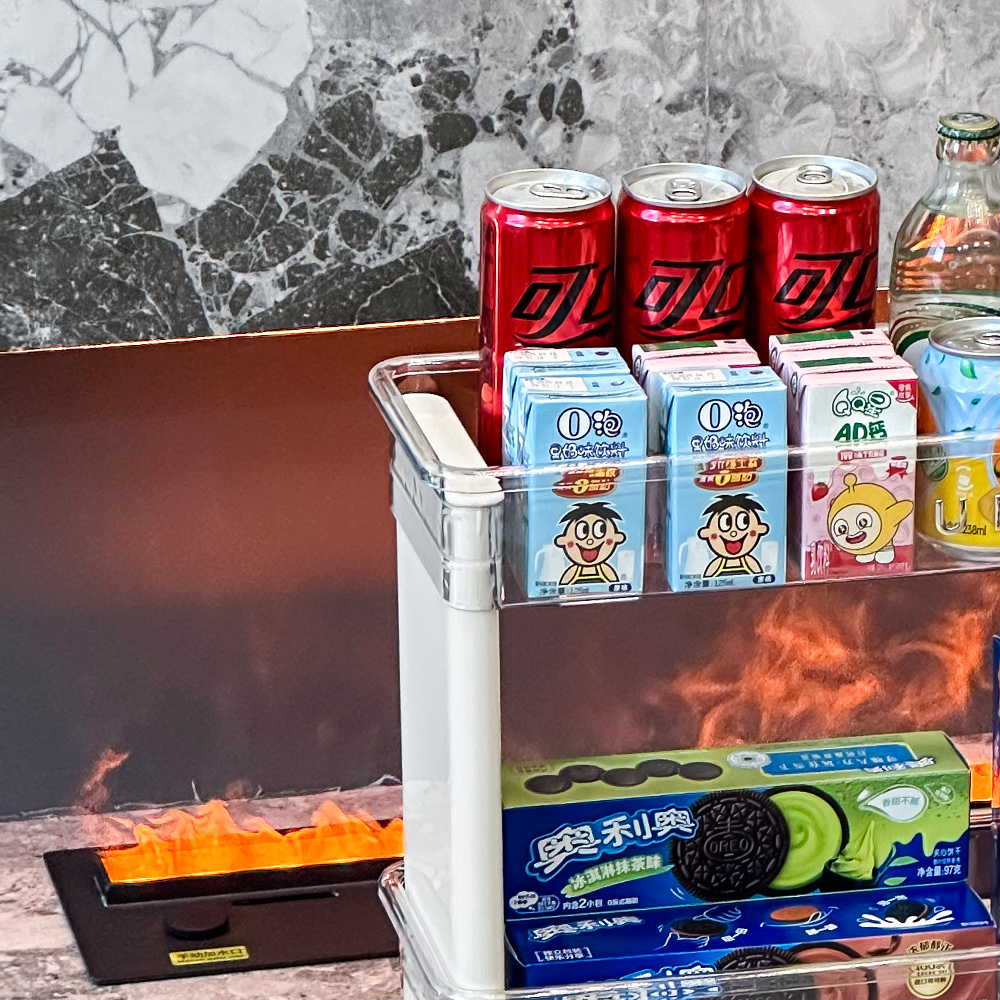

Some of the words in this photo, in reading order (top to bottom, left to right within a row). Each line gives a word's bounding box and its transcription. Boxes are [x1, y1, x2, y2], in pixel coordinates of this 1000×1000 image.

[533, 808, 696, 874] 奥利奥
[707, 836, 751, 856] OREO
[570, 854, 662, 891] 冰淇淋抹茶味
